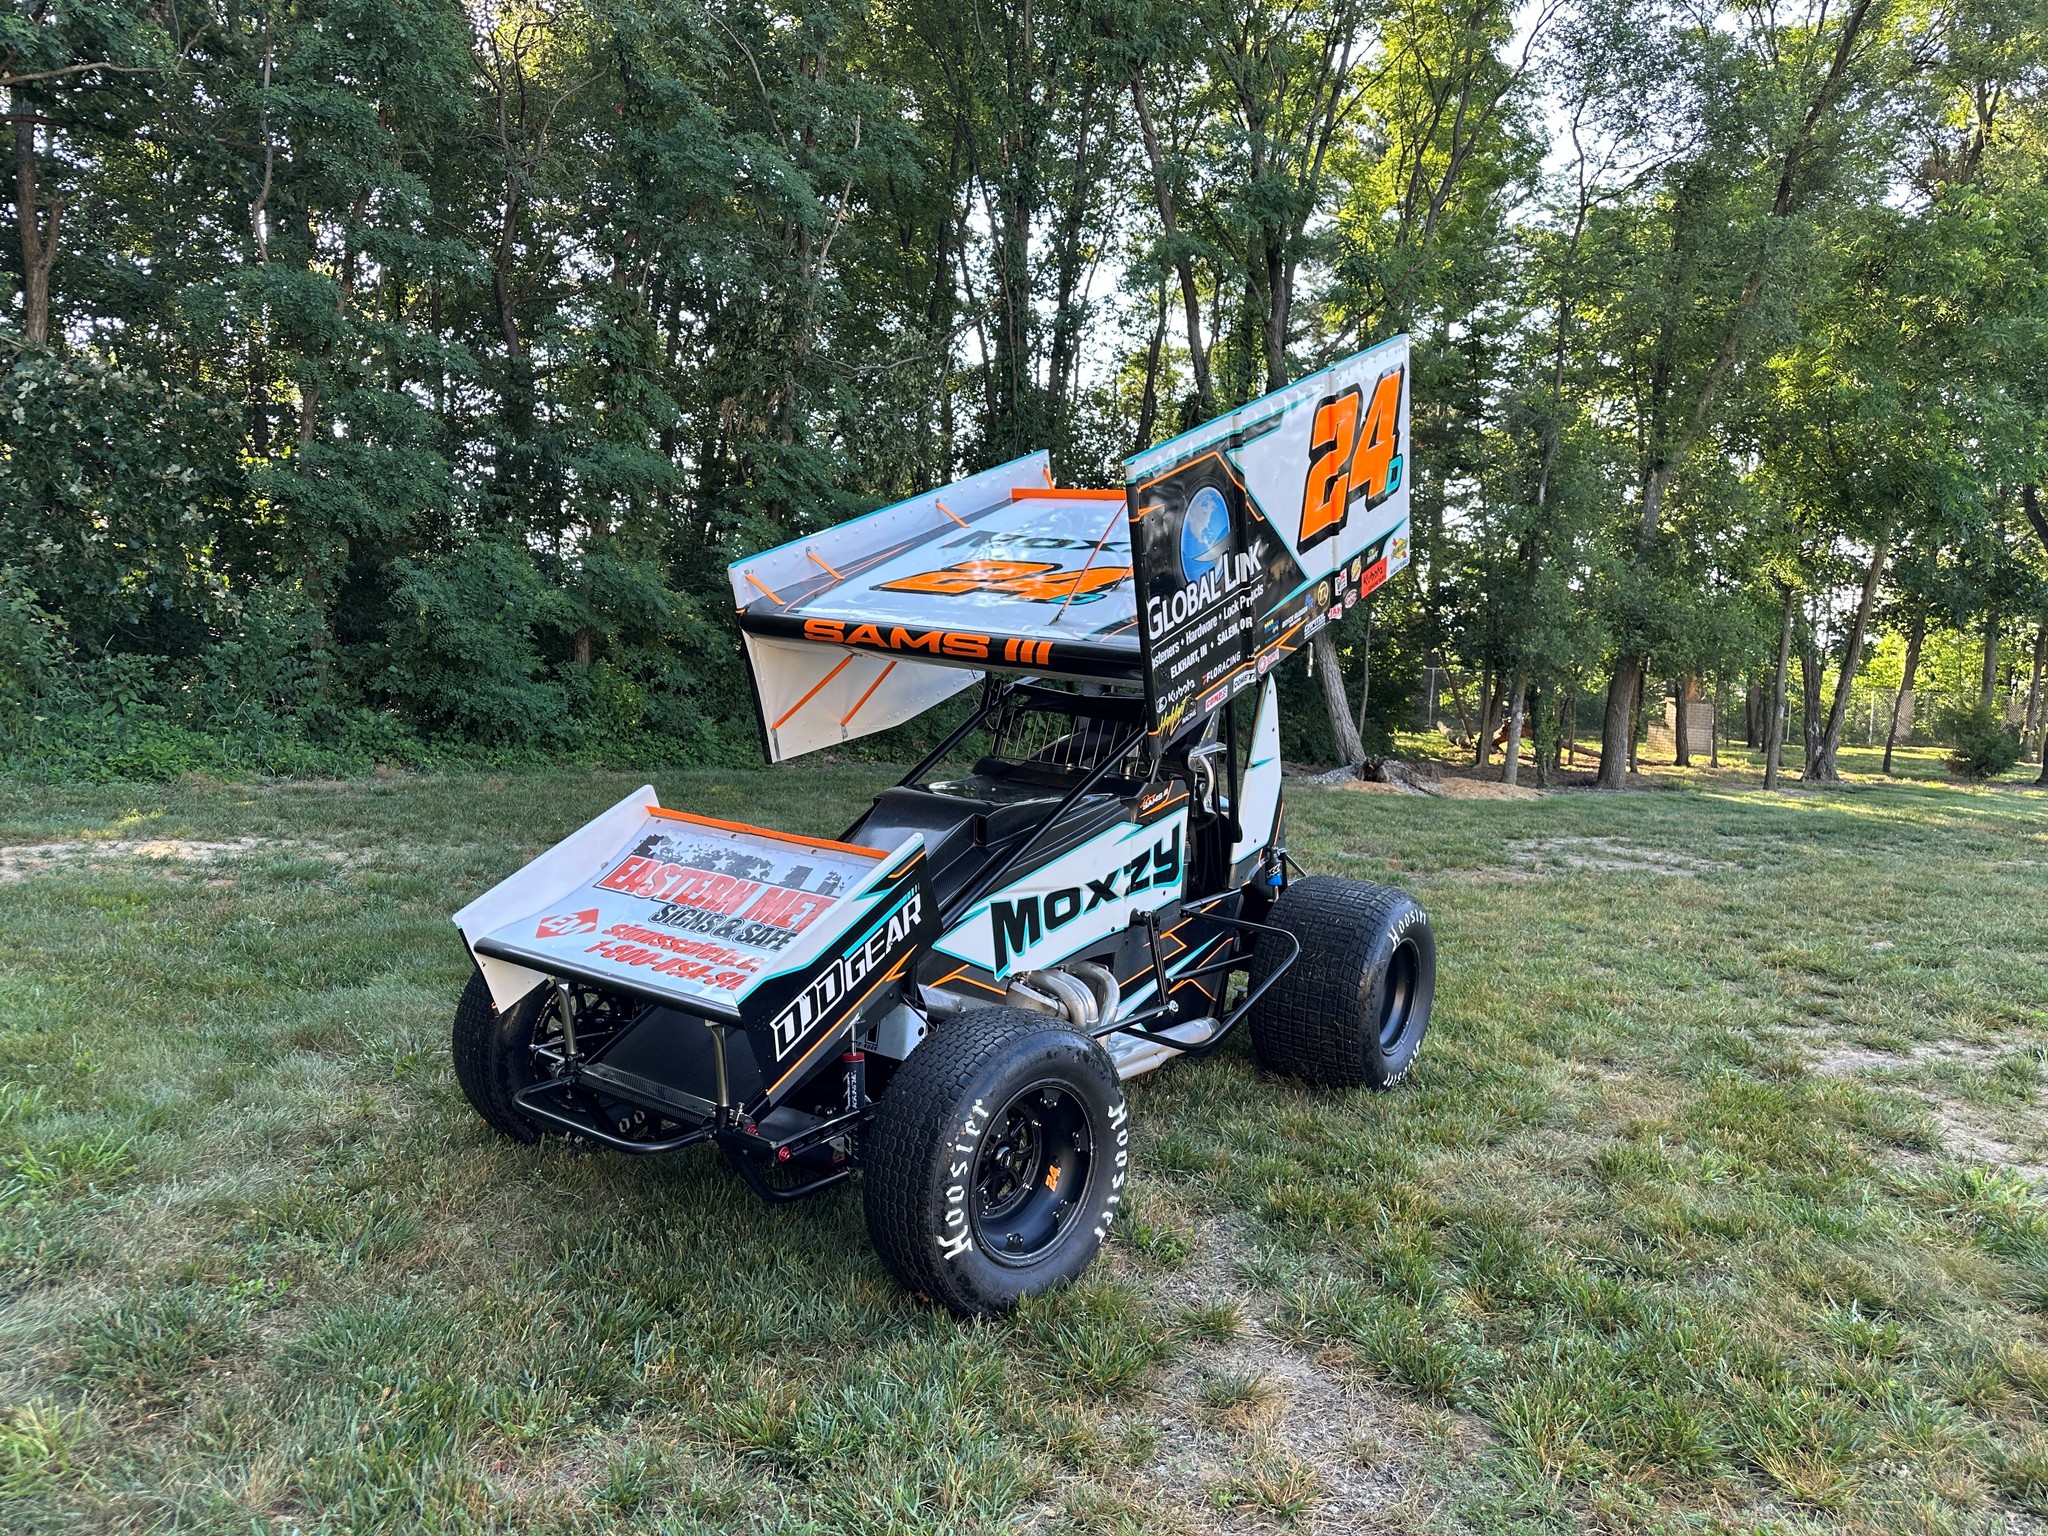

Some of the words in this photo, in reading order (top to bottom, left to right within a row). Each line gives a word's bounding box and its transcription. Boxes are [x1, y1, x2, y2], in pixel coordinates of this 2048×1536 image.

[1146, 568, 1221, 640] GLOBAL
[1223, 541, 1262, 593] LINK
[1186, 616, 1218, 645] Hardware
[1223, 600, 1240, 620] Lock
[804, 619, 990, 658] SAMS
[1005, 638, 1053, 665] III
[1170, 650, 1200, 680] ELKHART,
[1217, 623, 1240, 646] SALEM,
[1240, 617, 1253, 630] OR
[1168, 679, 1196, 702] Kubota
[598, 856, 762, 916] EASTERN
[744, 884, 837, 931] MET
[735, 923, 799, 952] SAFE
[845, 893, 921, 991] GEAR
[936, 1098, 989, 1260] Hoosier
[1094, 1098, 1128, 1243] Hoosier
